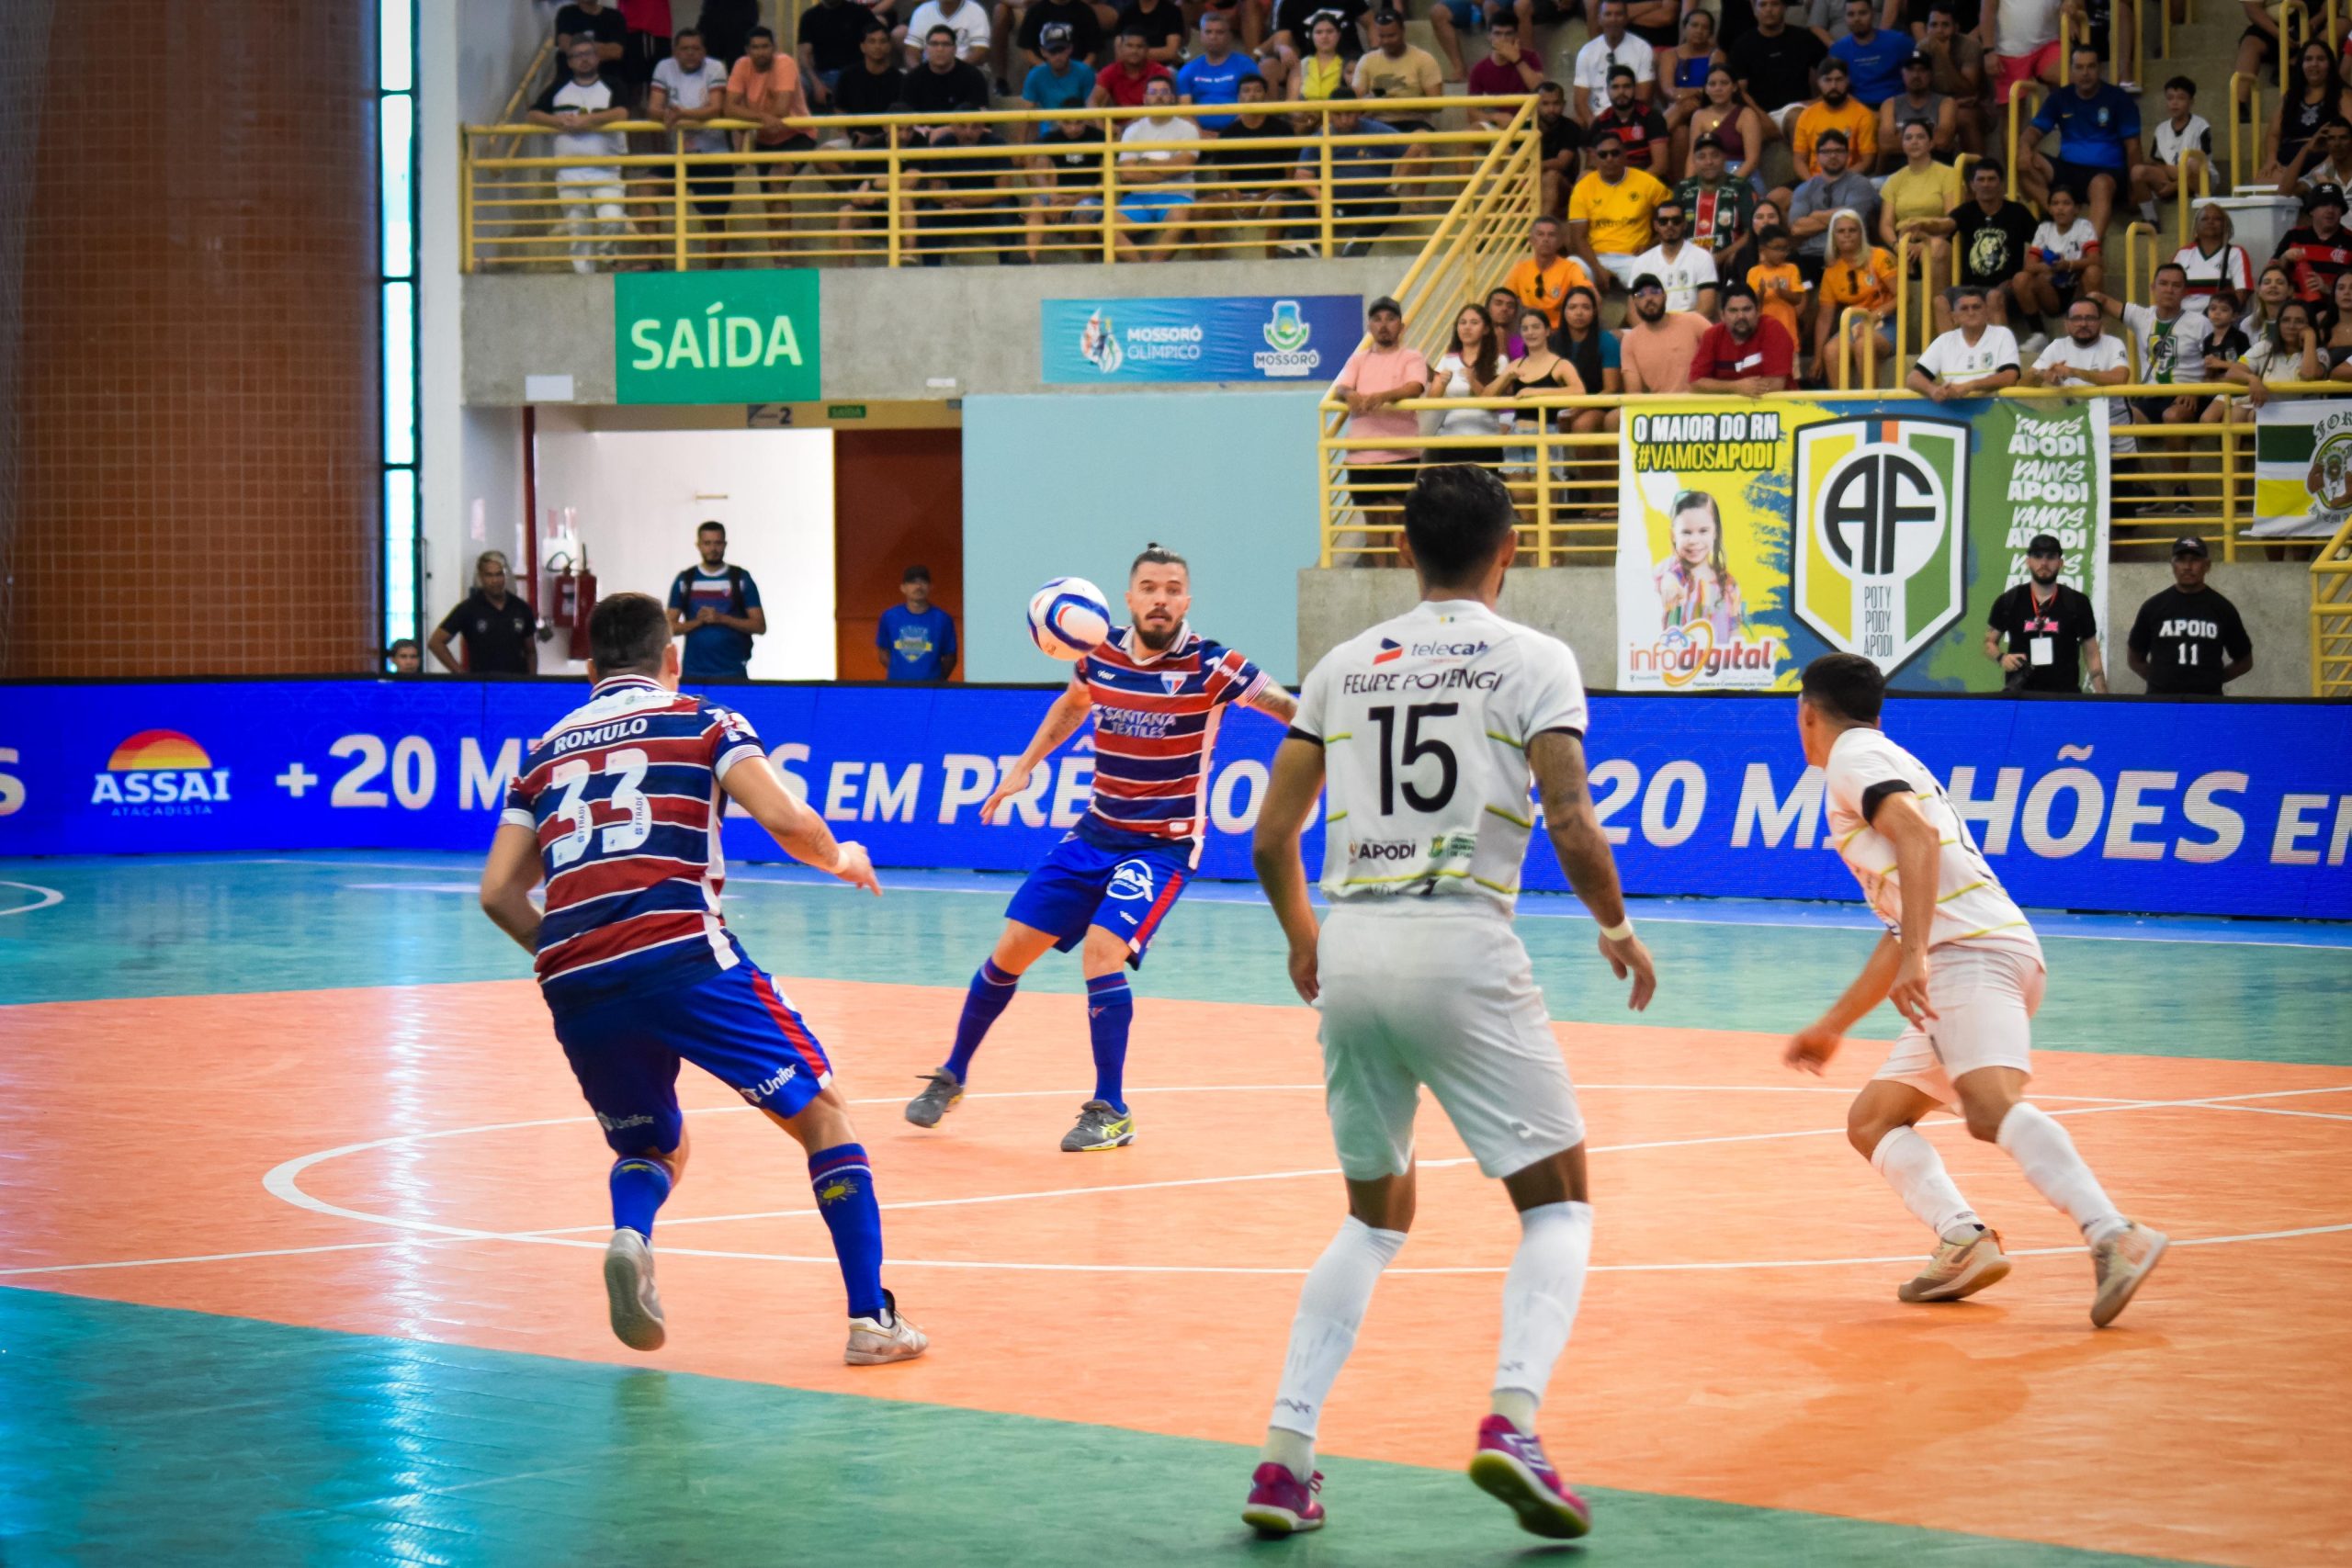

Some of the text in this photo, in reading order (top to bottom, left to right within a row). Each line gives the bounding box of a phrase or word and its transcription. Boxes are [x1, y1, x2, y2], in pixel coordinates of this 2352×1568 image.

[631, 302, 803, 370] SAÍDA
[1127, 324, 1203, 342] MOSSORÓ
[1127, 344, 1200, 359] OLÍMPICO
[1255, 350, 1317, 366] MOSSORÓ
[1634, 413, 1778, 443] O MAIOR DO RN
[1637, 442, 1773, 470] #VAMOSAPODI
[2007, 434, 2086, 457] APODI
[2012, 458, 2086, 483] VAMOS
[2007, 480, 2088, 503] APODI
[2011, 505, 2086, 529] VAMOS
[1864, 586, 1891, 609] POTY
[1865, 611, 1891, 633] PODY
[2159, 620, 2218, 639] APOIO
[1864, 635, 1893, 657] APODI
[2178, 643, 2198, 665] 11
[1630, 641, 1770, 676] infodigital
[1343, 673, 1400, 694] FELIPE
[1104, 706, 1177, 727] SANTANA
[553, 717, 648, 755] ROMULO
[1112, 723, 1167, 739] TEXTILES
[1368, 702, 1459, 816] 15
[111, 805, 212, 817] ATACADISTA
[551, 748, 652, 869] 33
[824, 761, 923, 824] EM
[1730, 744, 2248, 863] MHÕES
[1359, 843, 1416, 860] APODI
[758, 1064, 797, 1096] Unifor
